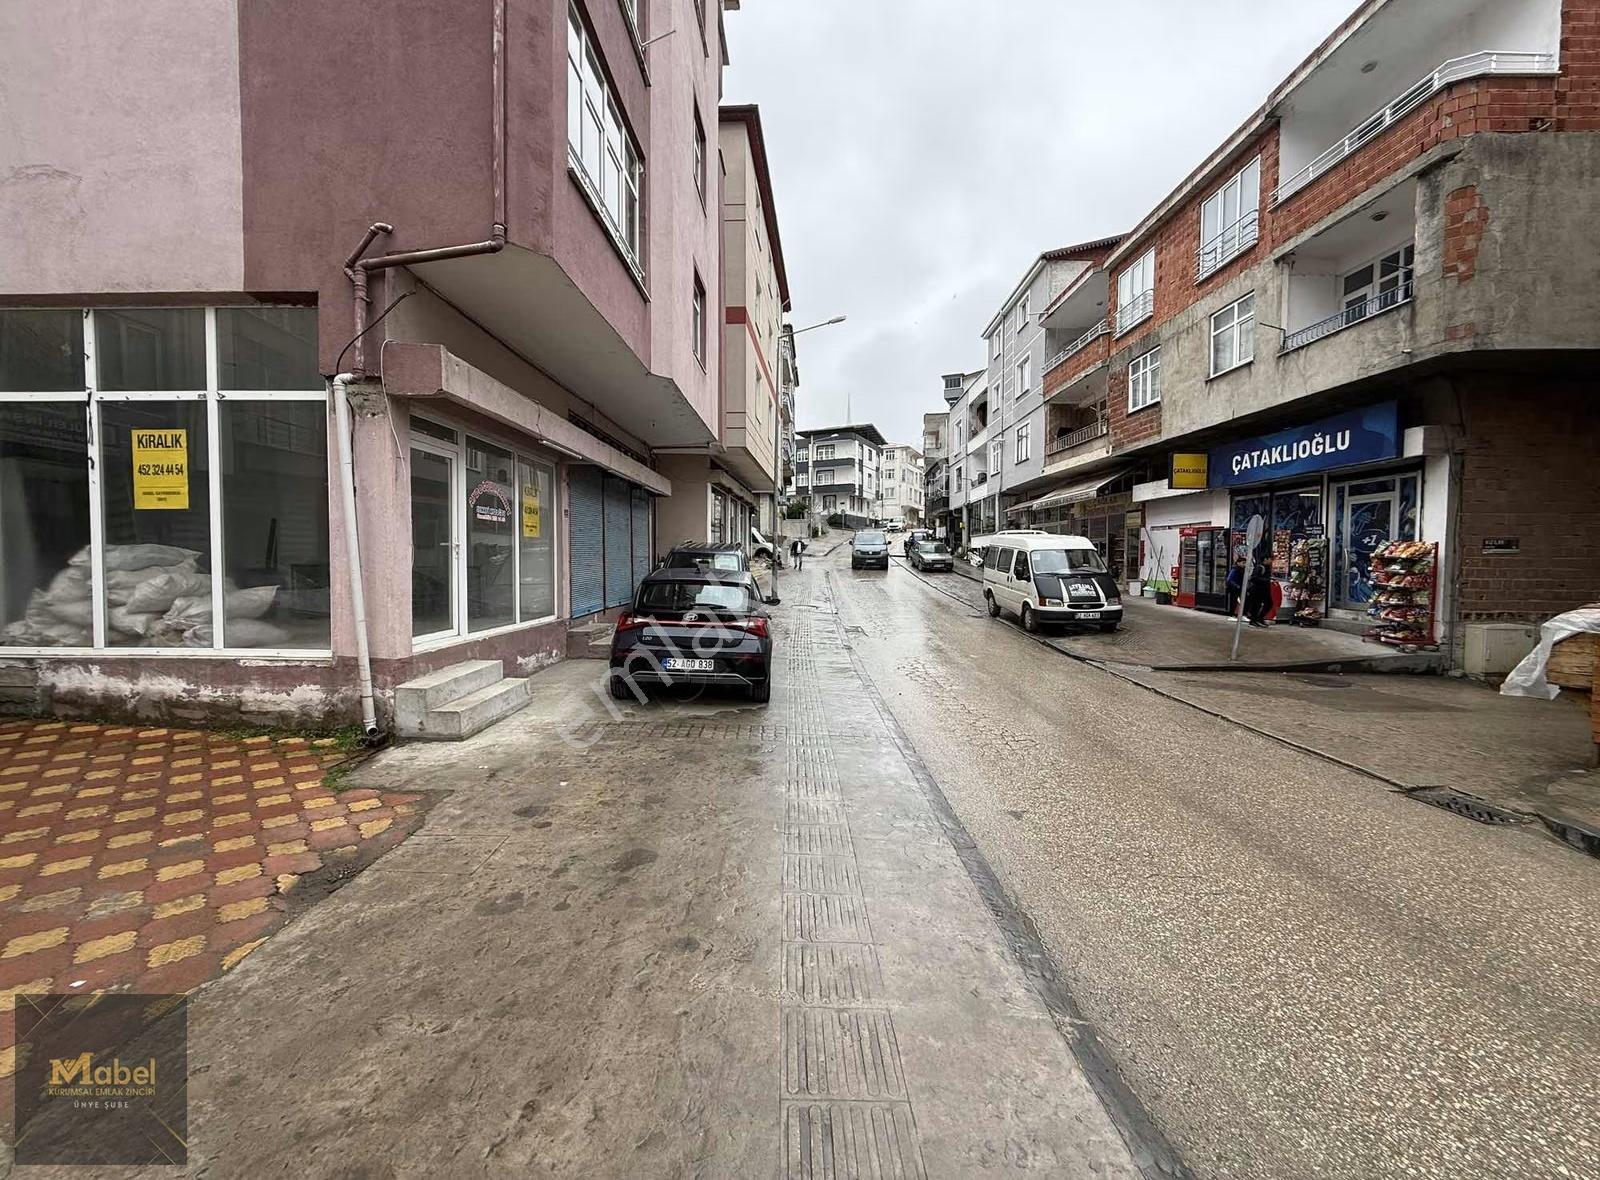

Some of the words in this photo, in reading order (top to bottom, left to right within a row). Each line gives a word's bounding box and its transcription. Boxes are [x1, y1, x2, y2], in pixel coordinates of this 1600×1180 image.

[1232, 430, 1350, 475] ÇATAKLIOĞLU
[138, 464, 151, 476] 452
[152, 464, 164, 476] 324
[166, 464, 174, 476] 44
[175, 464, 183, 476] 54
[667, 659, 677, 668] 52
[698, 661, 713, 669] 838
